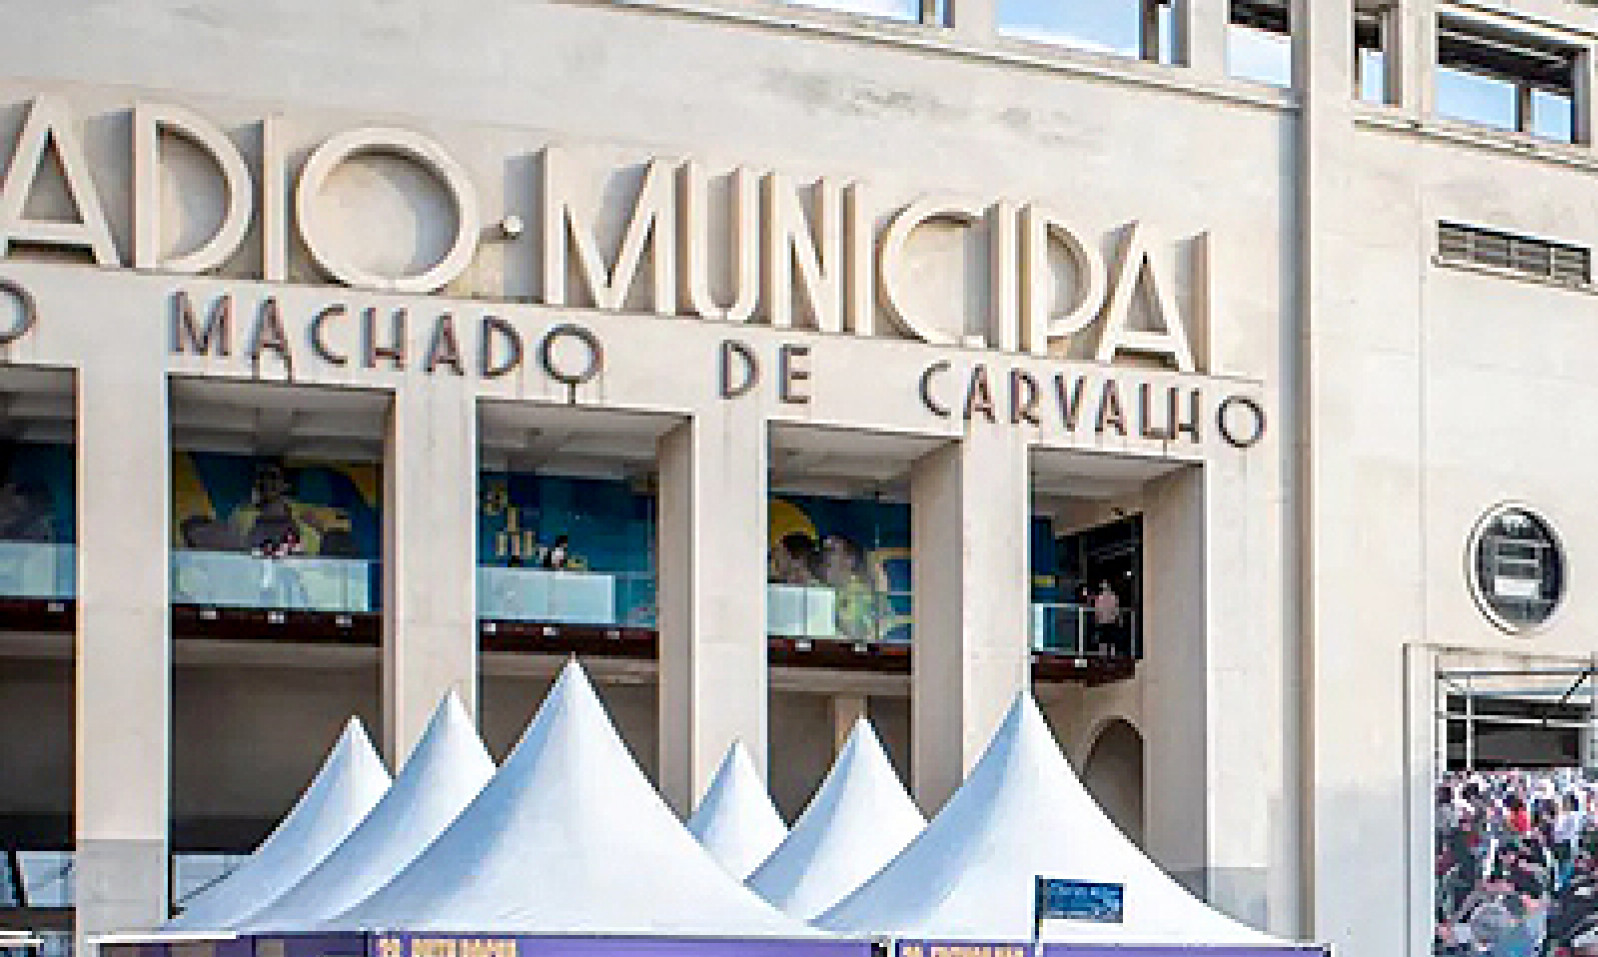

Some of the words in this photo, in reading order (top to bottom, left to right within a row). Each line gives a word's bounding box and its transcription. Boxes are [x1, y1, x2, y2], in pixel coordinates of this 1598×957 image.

[540, 146, 1218, 376] MUNICIPAL
[170, 290, 606, 384] MACHADO
[718, 338, 813, 404] DE
[917, 360, 1268, 449] CARVALHO
